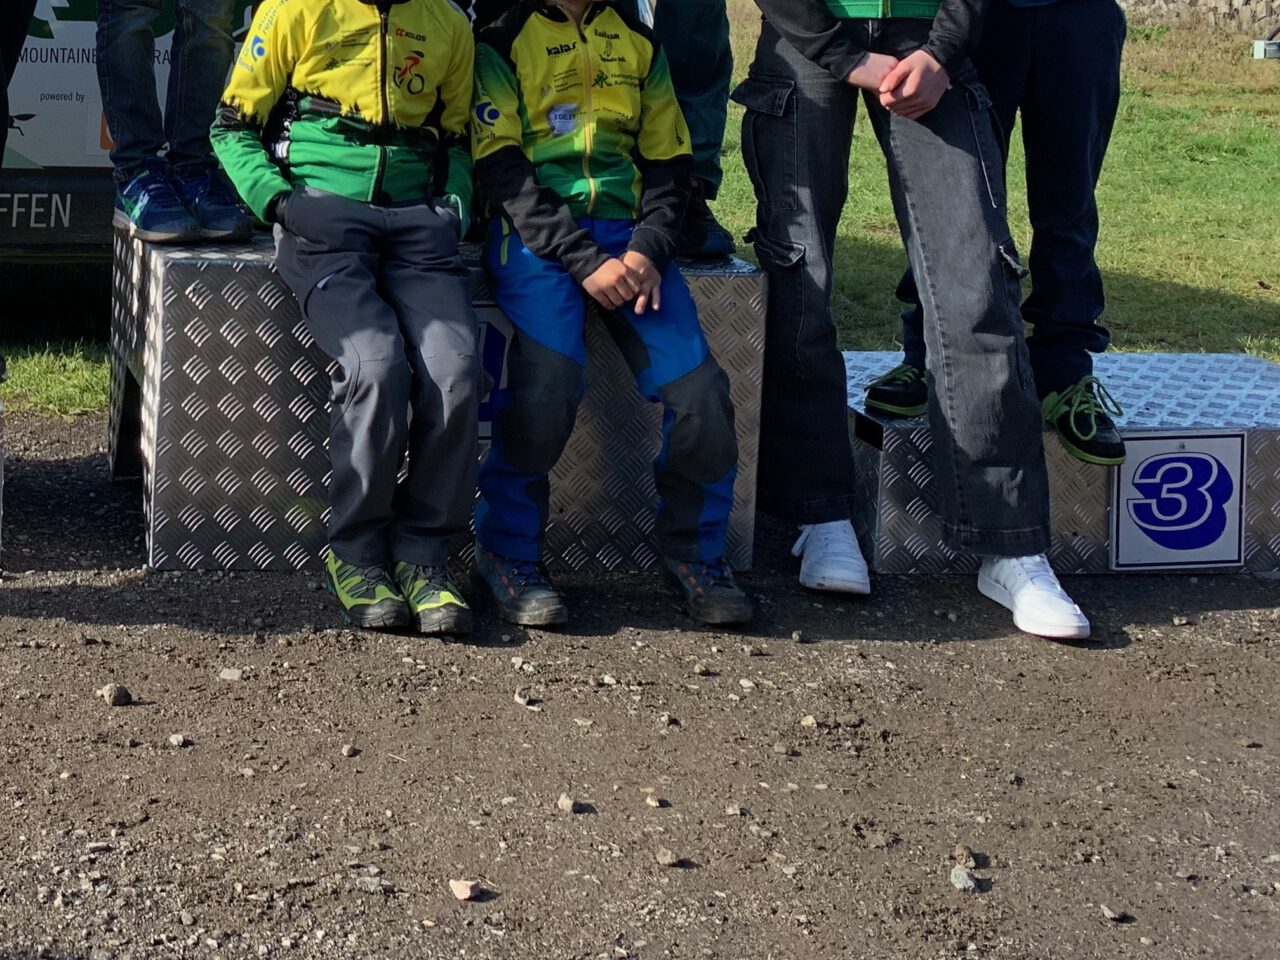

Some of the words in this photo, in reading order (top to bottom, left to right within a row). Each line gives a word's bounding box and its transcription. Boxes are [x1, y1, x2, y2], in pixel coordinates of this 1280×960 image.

[546, 41, 577, 57] kalas
[39, 92, 73, 102] powered
[75, 92, 86, 103] by
[1126, 451, 1235, 551] 3
